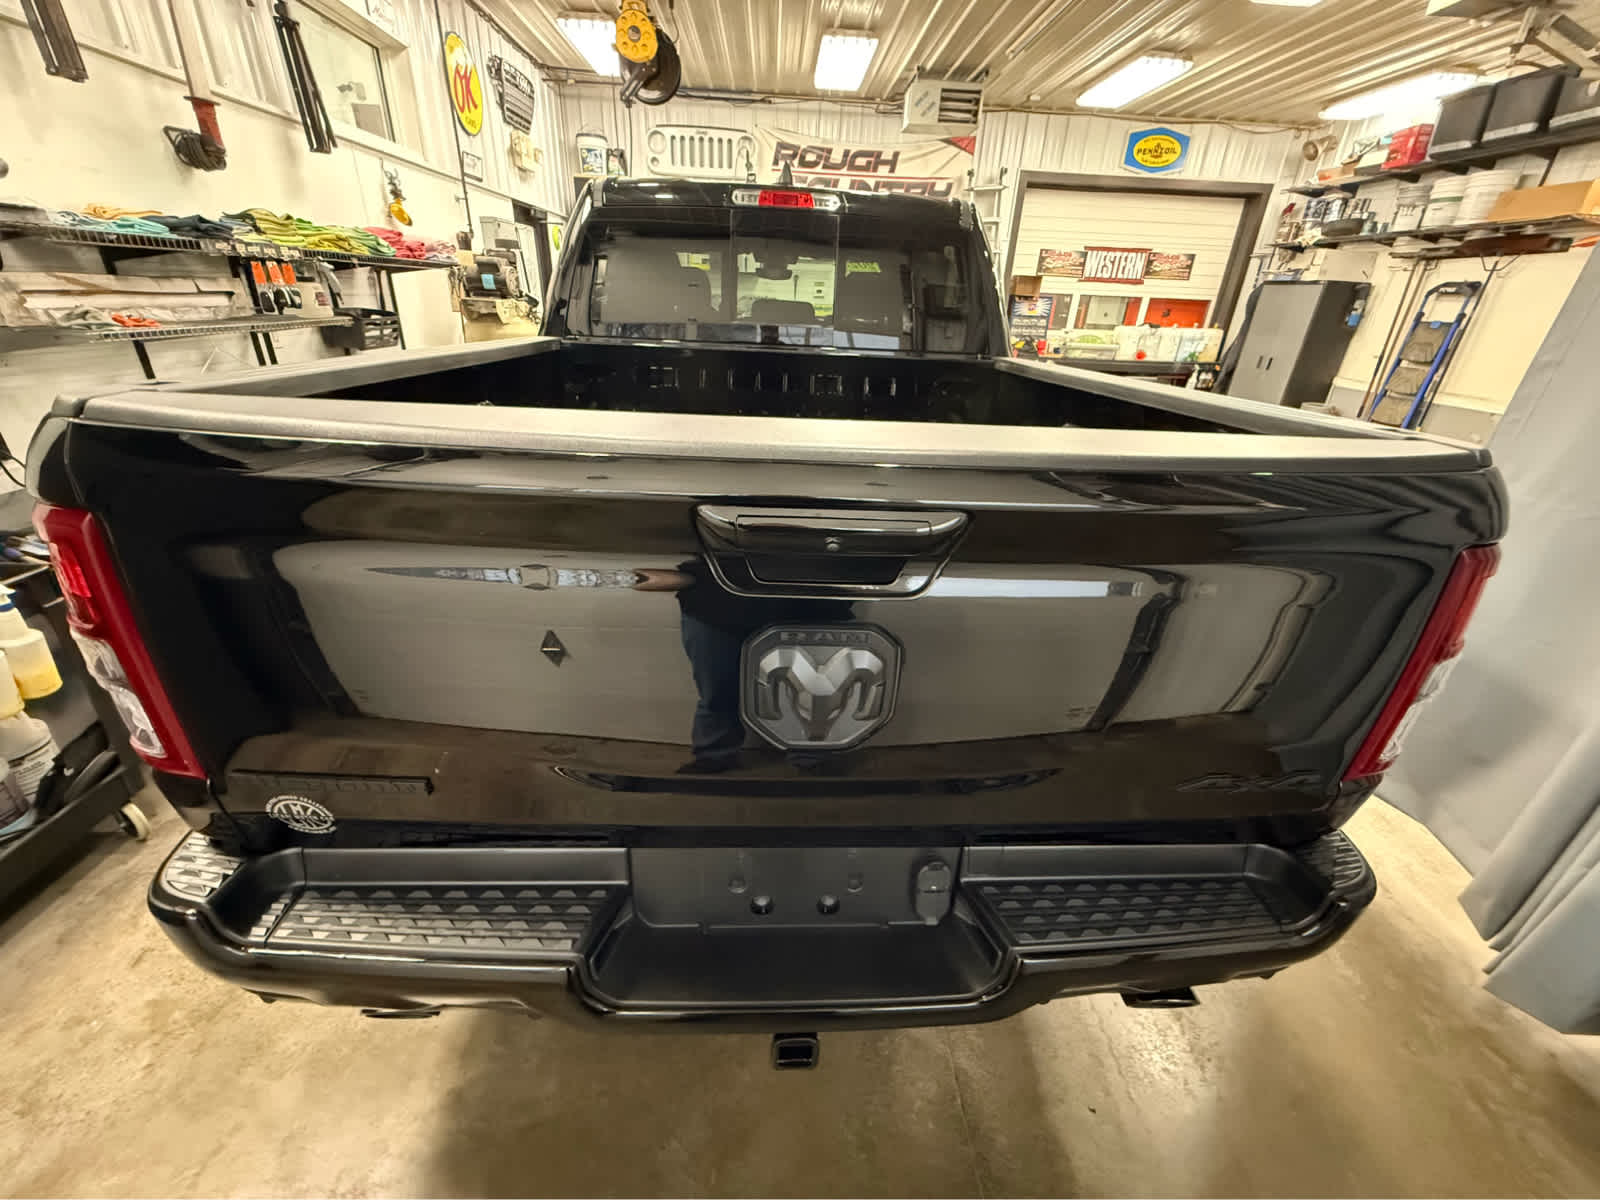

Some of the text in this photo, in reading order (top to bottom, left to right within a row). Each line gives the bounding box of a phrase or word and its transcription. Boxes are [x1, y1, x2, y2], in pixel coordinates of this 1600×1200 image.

[453, 61, 478, 114] OK
[771, 141, 900, 174] ROUGH
[1136, 146, 1178, 156] PENNZOIL
[1085, 249, 1147, 280] WESTERN
[779, 631, 872, 643] RAM
